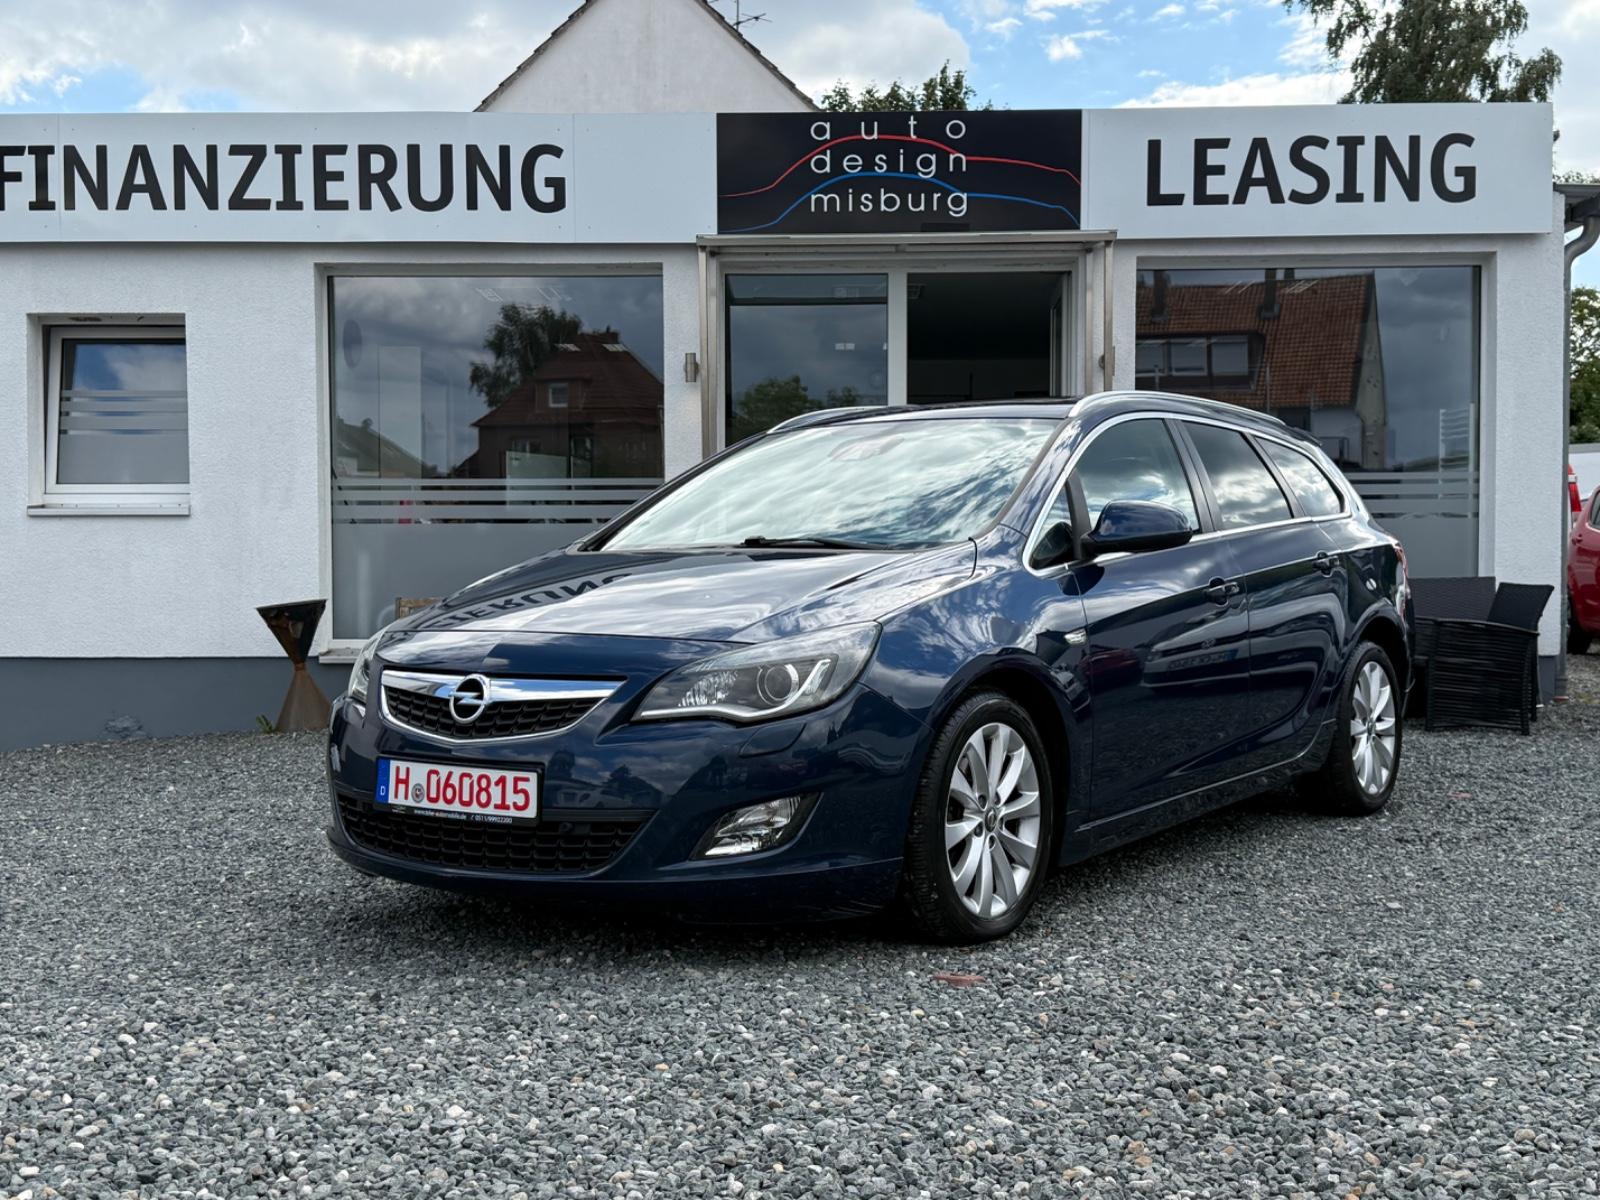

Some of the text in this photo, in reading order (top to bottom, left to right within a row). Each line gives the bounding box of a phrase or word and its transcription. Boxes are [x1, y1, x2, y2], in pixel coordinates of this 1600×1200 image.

[810, 115, 967, 141] auto
[0, 143, 567, 214] FINANZIERUNG
[810, 148, 967, 179] design
[1146, 132, 1477, 206] LEASING
[810, 187, 969, 217] misburg
[380, 785, 386, 796] D
[394, 765, 531, 812] H 060815
